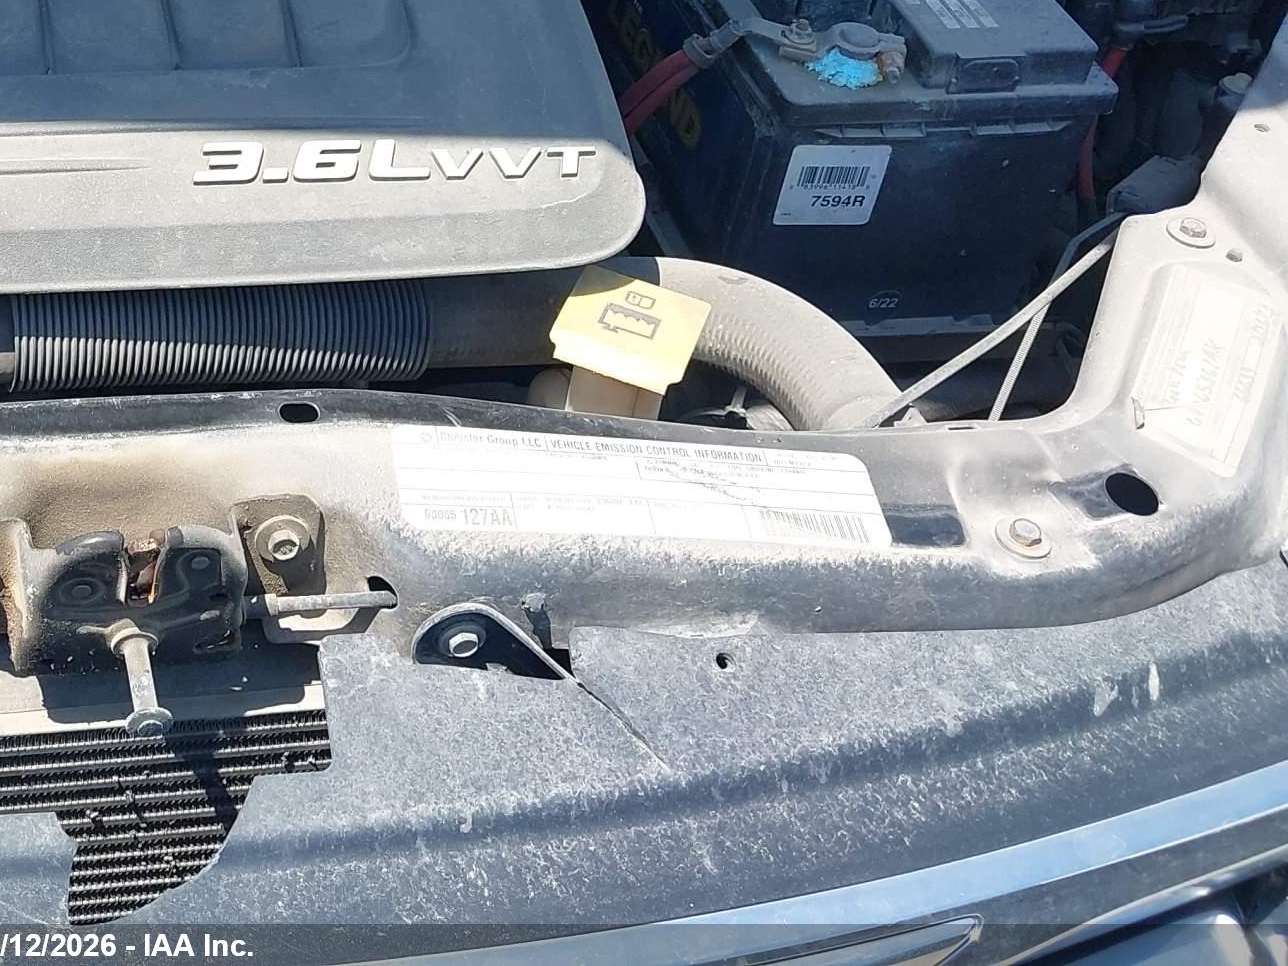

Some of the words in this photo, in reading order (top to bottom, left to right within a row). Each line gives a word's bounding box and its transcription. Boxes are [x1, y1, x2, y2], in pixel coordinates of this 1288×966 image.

[810, 195, 866, 208] 7594R
[868, 297, 900, 309] 6/22
[440, 432, 484, 444] Chrysler
[487, 434, 519, 449] Group
[522, 436, 542, 448] LLC
[551, 440, 593, 452] VEHICLE
[595, 442, 644, 455] EMISSION
[646, 445, 692, 459] CONTROL
[694, 448, 762, 464] INFORMATION
[463, 507, 513, 526] 127AA
